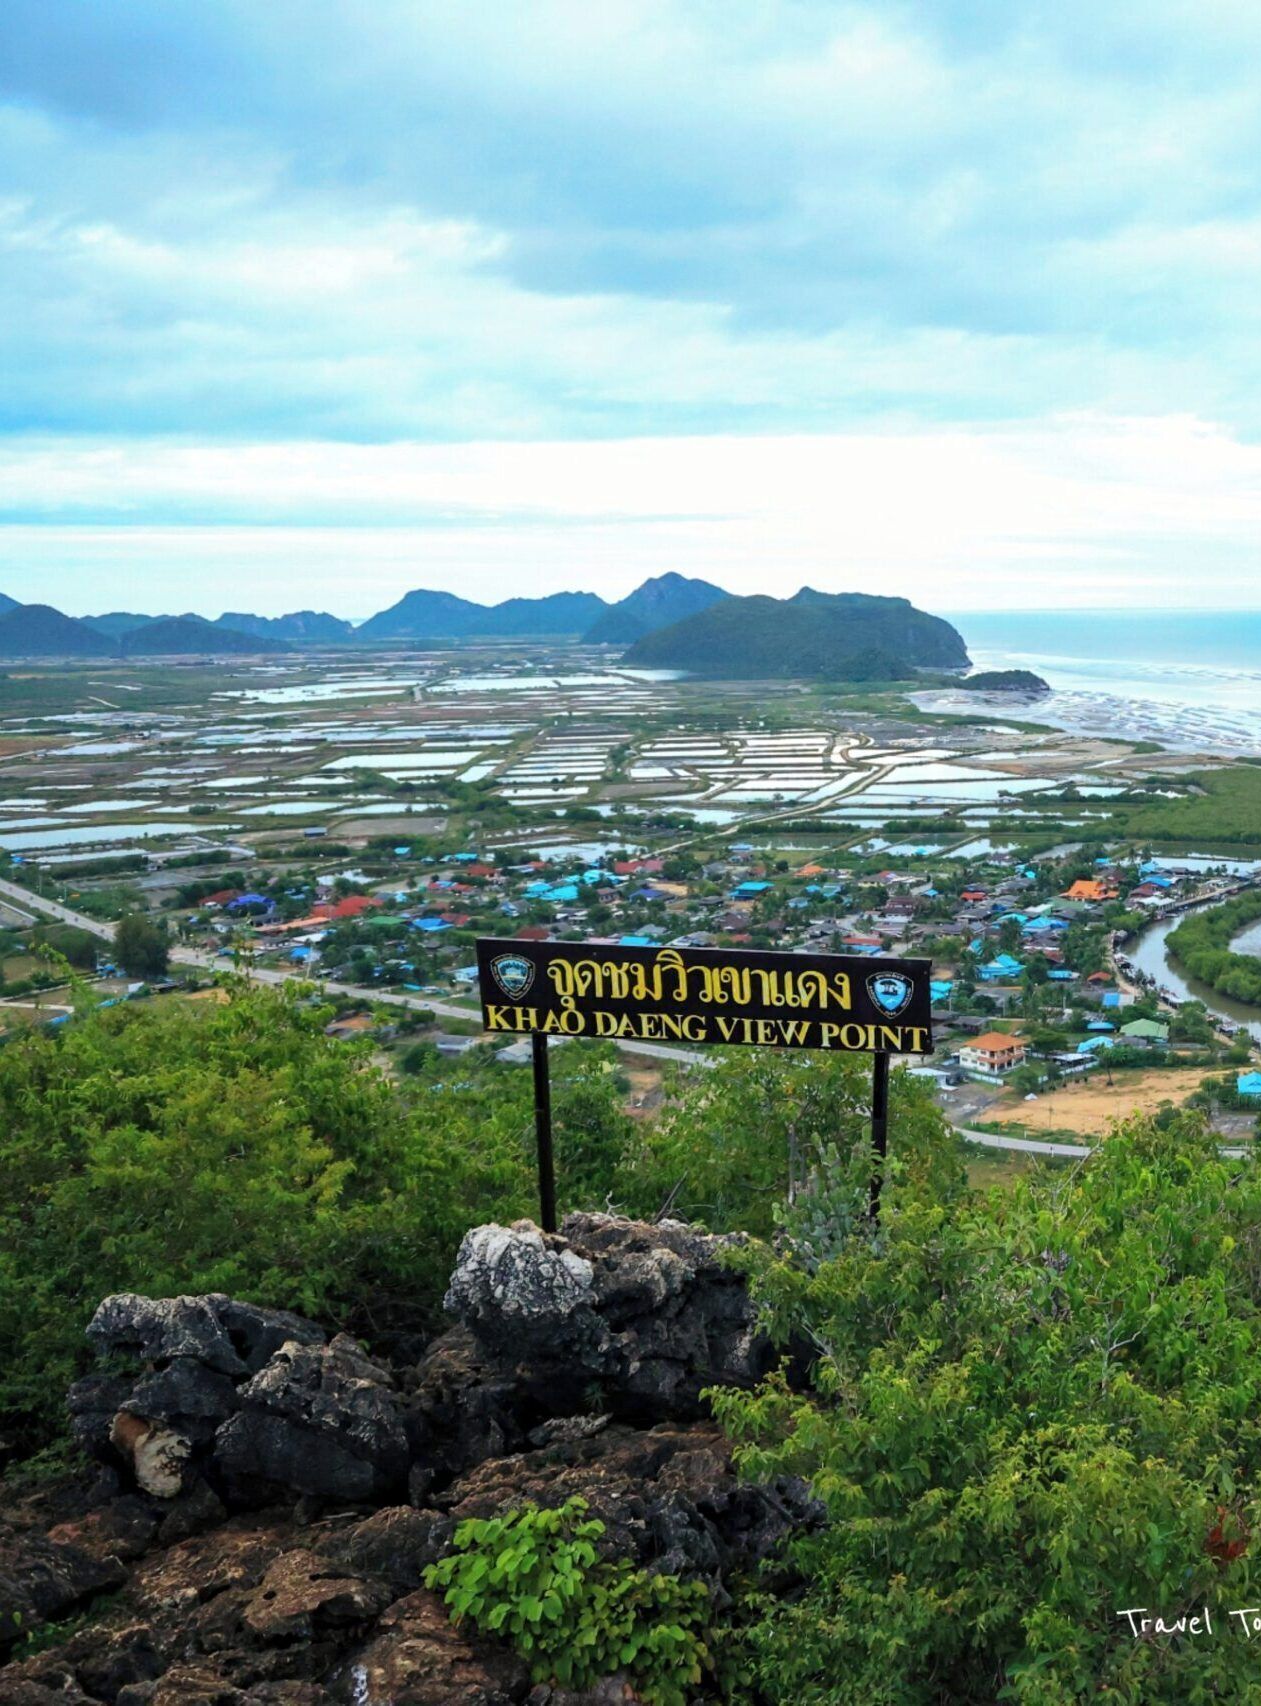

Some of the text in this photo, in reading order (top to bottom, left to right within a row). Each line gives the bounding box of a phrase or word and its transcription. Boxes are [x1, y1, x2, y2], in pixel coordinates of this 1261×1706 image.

[547, 949, 852, 1012] จุดชมวิวเขาแดง
[485, 1004, 928, 1053] KHAO DAENG VIEW POINT
